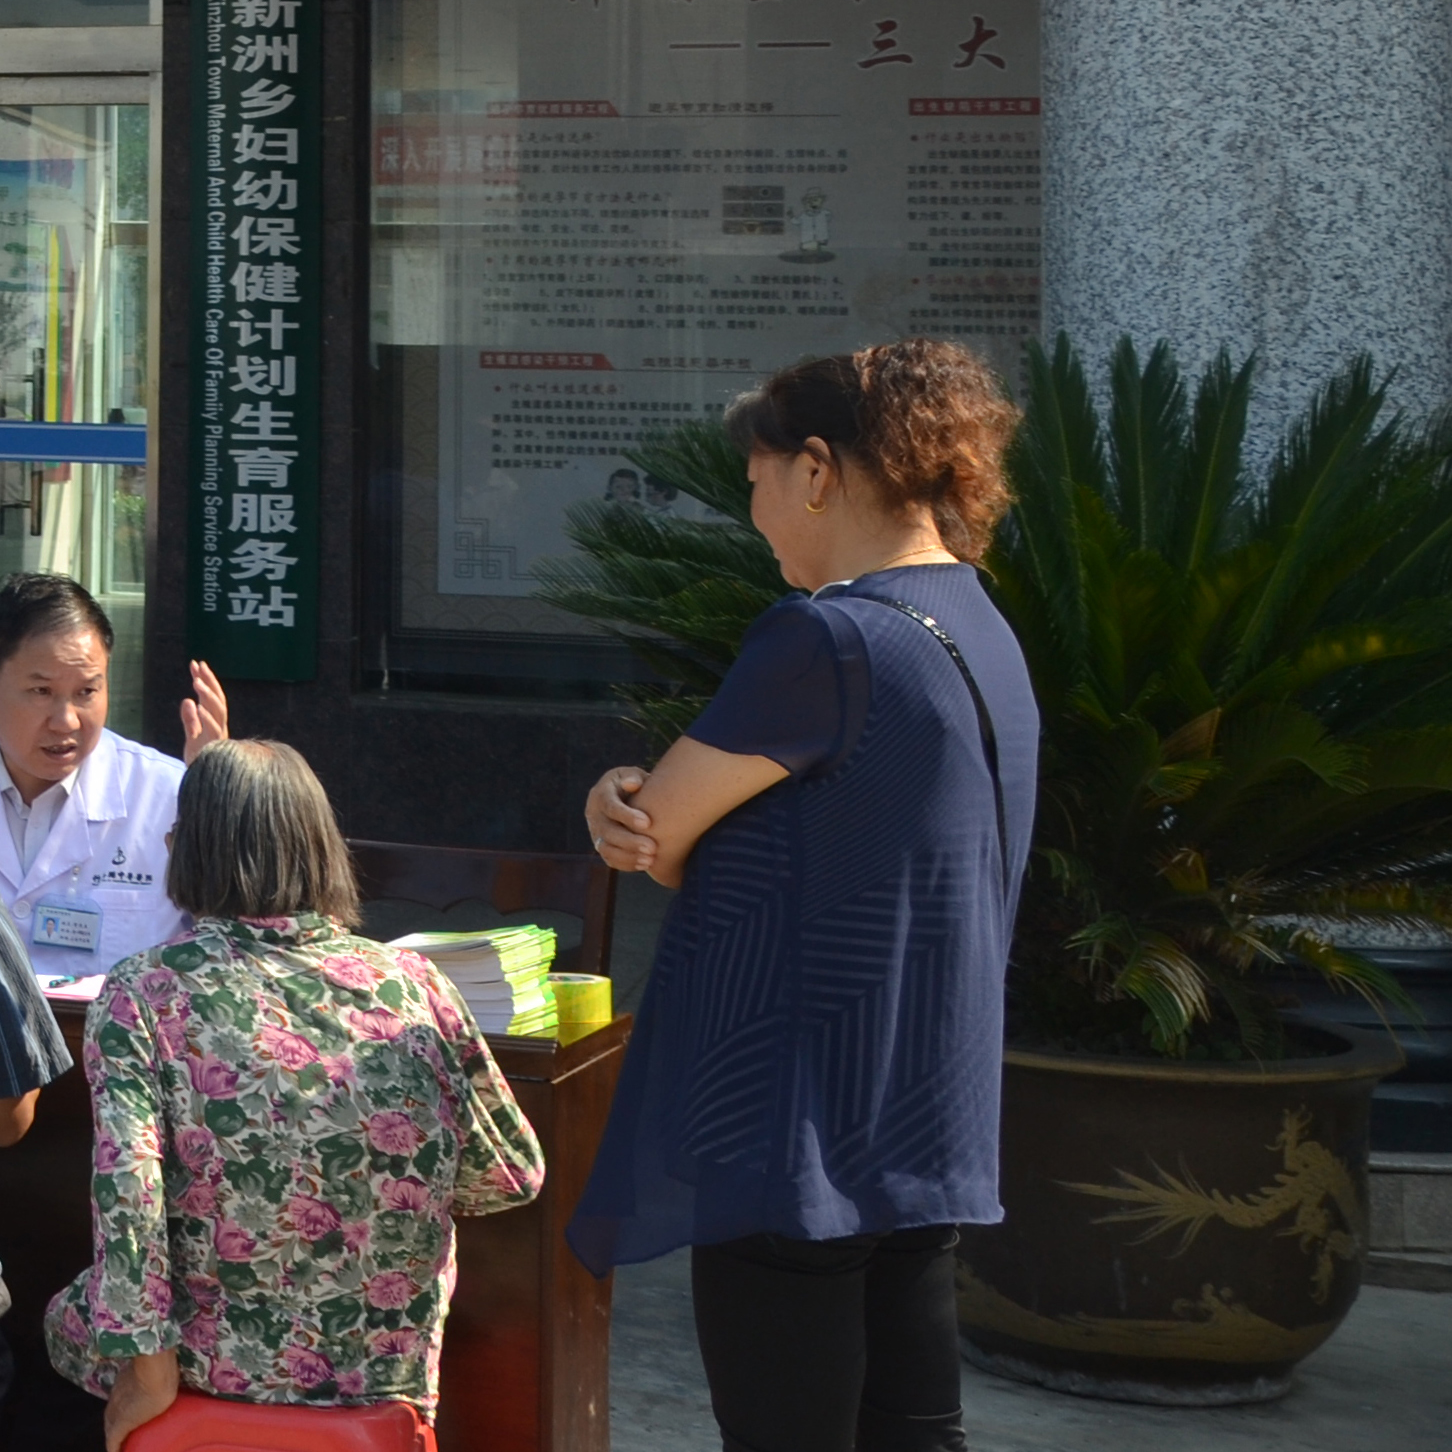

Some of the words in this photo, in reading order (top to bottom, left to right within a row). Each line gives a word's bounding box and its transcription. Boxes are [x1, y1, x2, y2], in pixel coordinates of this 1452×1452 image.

[207, 56, 227, 100] Town
[207, 103, 227, 172] Maternal
[206, 176, 226, 207] And
[206, 210, 226, 250] Child
[206, 254, 226, 304] Health
[205, 308, 225, 344] Care
[205, 347, 225, 366] Of
[199, 424, 223, 492] Planning
[203, 495, 223, 552] Service
[202, 555, 223, 612] Station
